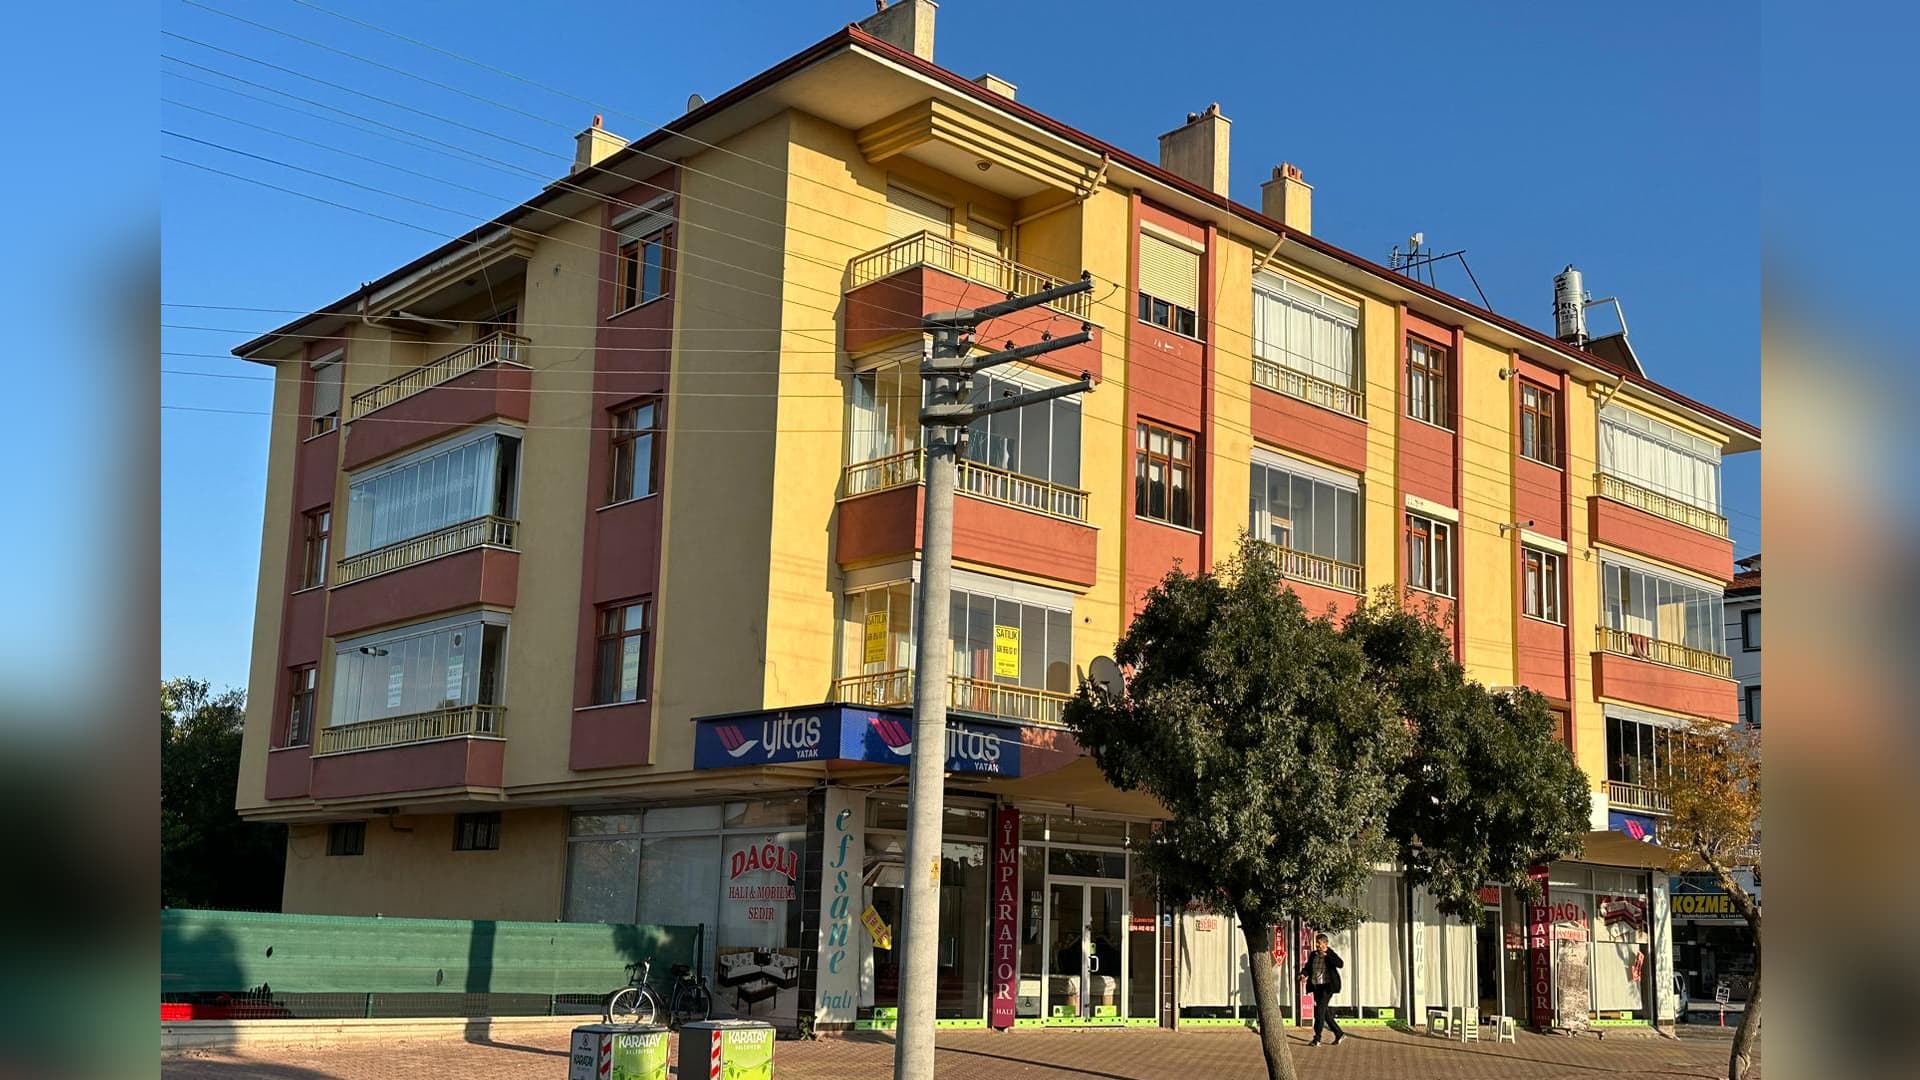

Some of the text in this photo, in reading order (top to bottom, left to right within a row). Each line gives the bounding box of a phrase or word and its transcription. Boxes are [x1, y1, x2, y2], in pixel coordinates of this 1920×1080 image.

[796, 749, 819, 759] YATAK
[974, 762, 999, 773] YATAK
[730, 836, 799, 881] DAĞLI
[996, 1008, 1014, 1016] HALI
[619, 1034, 661, 1048] KARATAY
[729, 1031, 769, 1044] KARATAY
